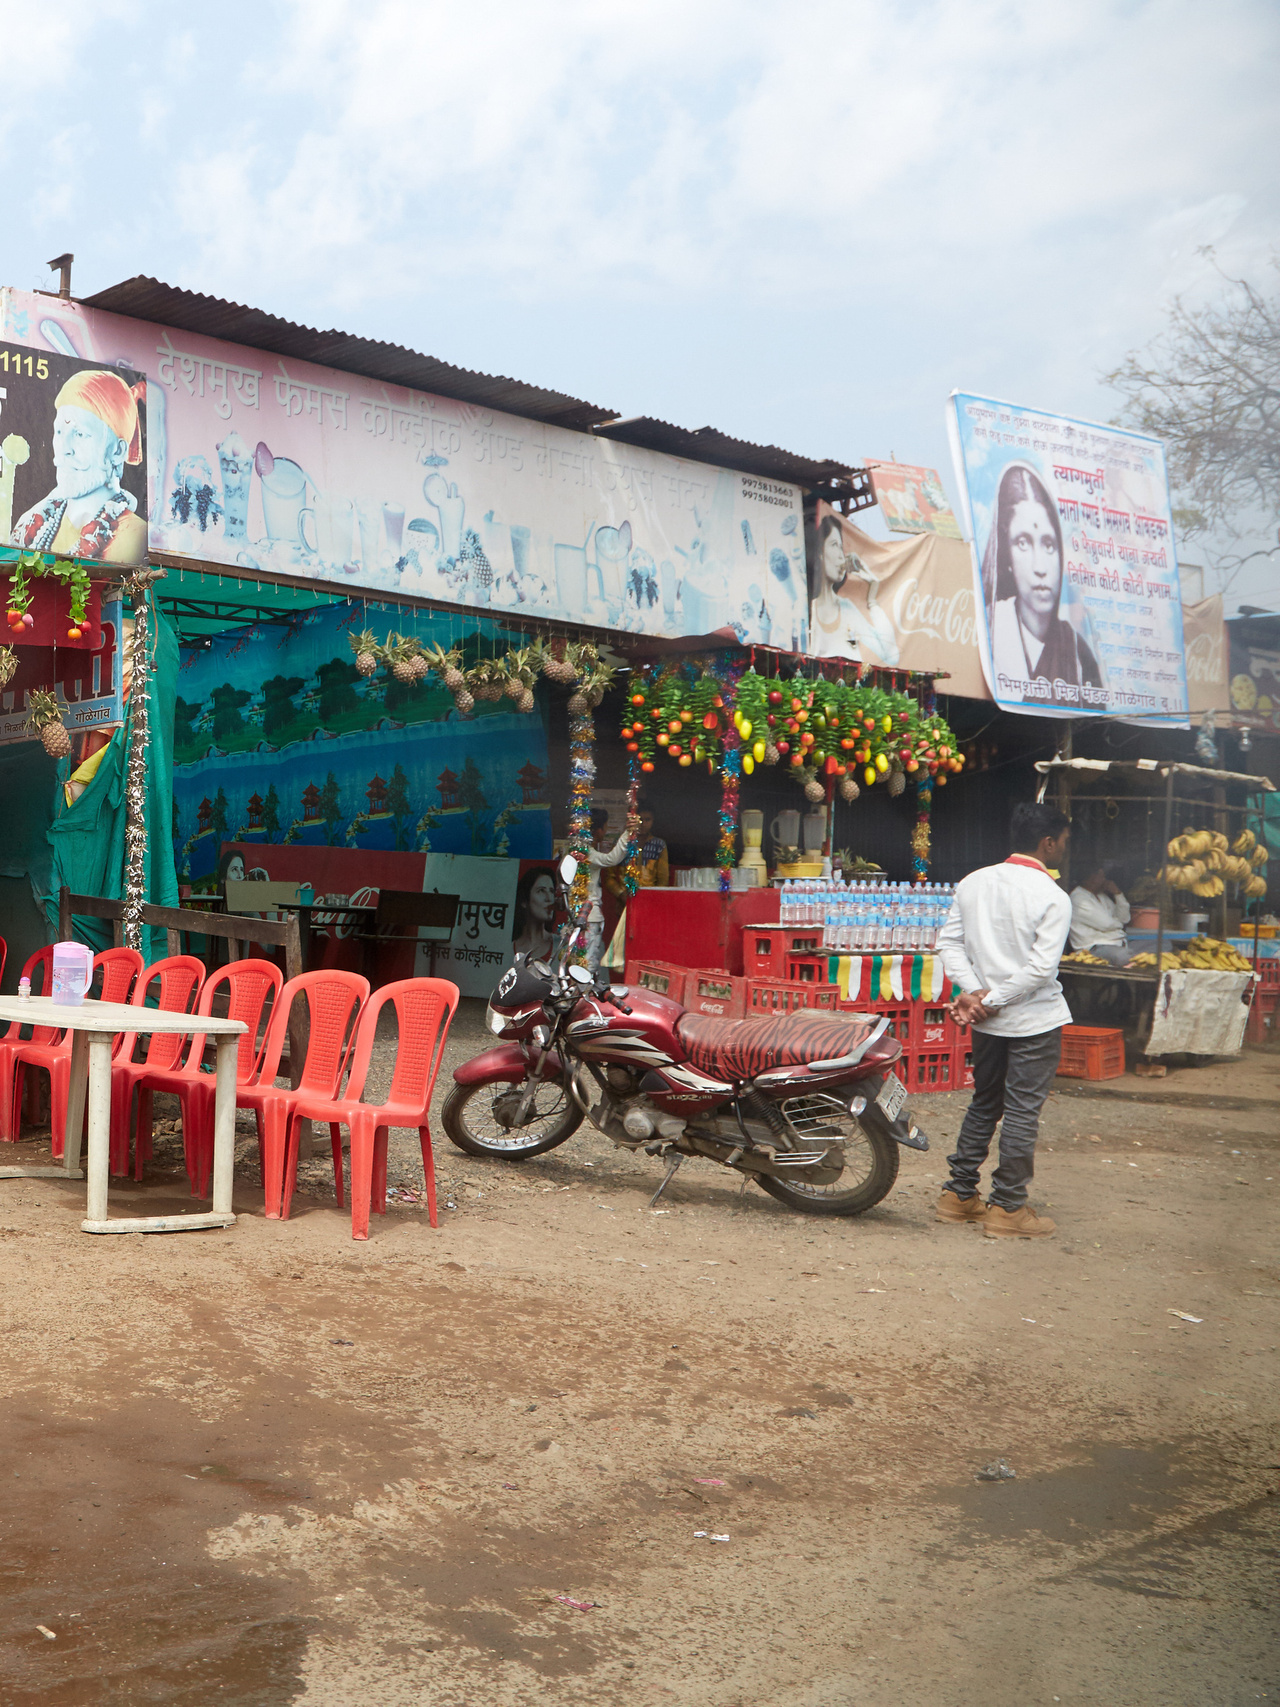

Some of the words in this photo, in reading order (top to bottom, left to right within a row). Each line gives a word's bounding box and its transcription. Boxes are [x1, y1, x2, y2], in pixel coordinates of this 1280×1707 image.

[156, 331, 263, 420] देशमुख
[272, 360, 350, 430] फेमस
[74, 705, 111, 724] गोळेगांव
